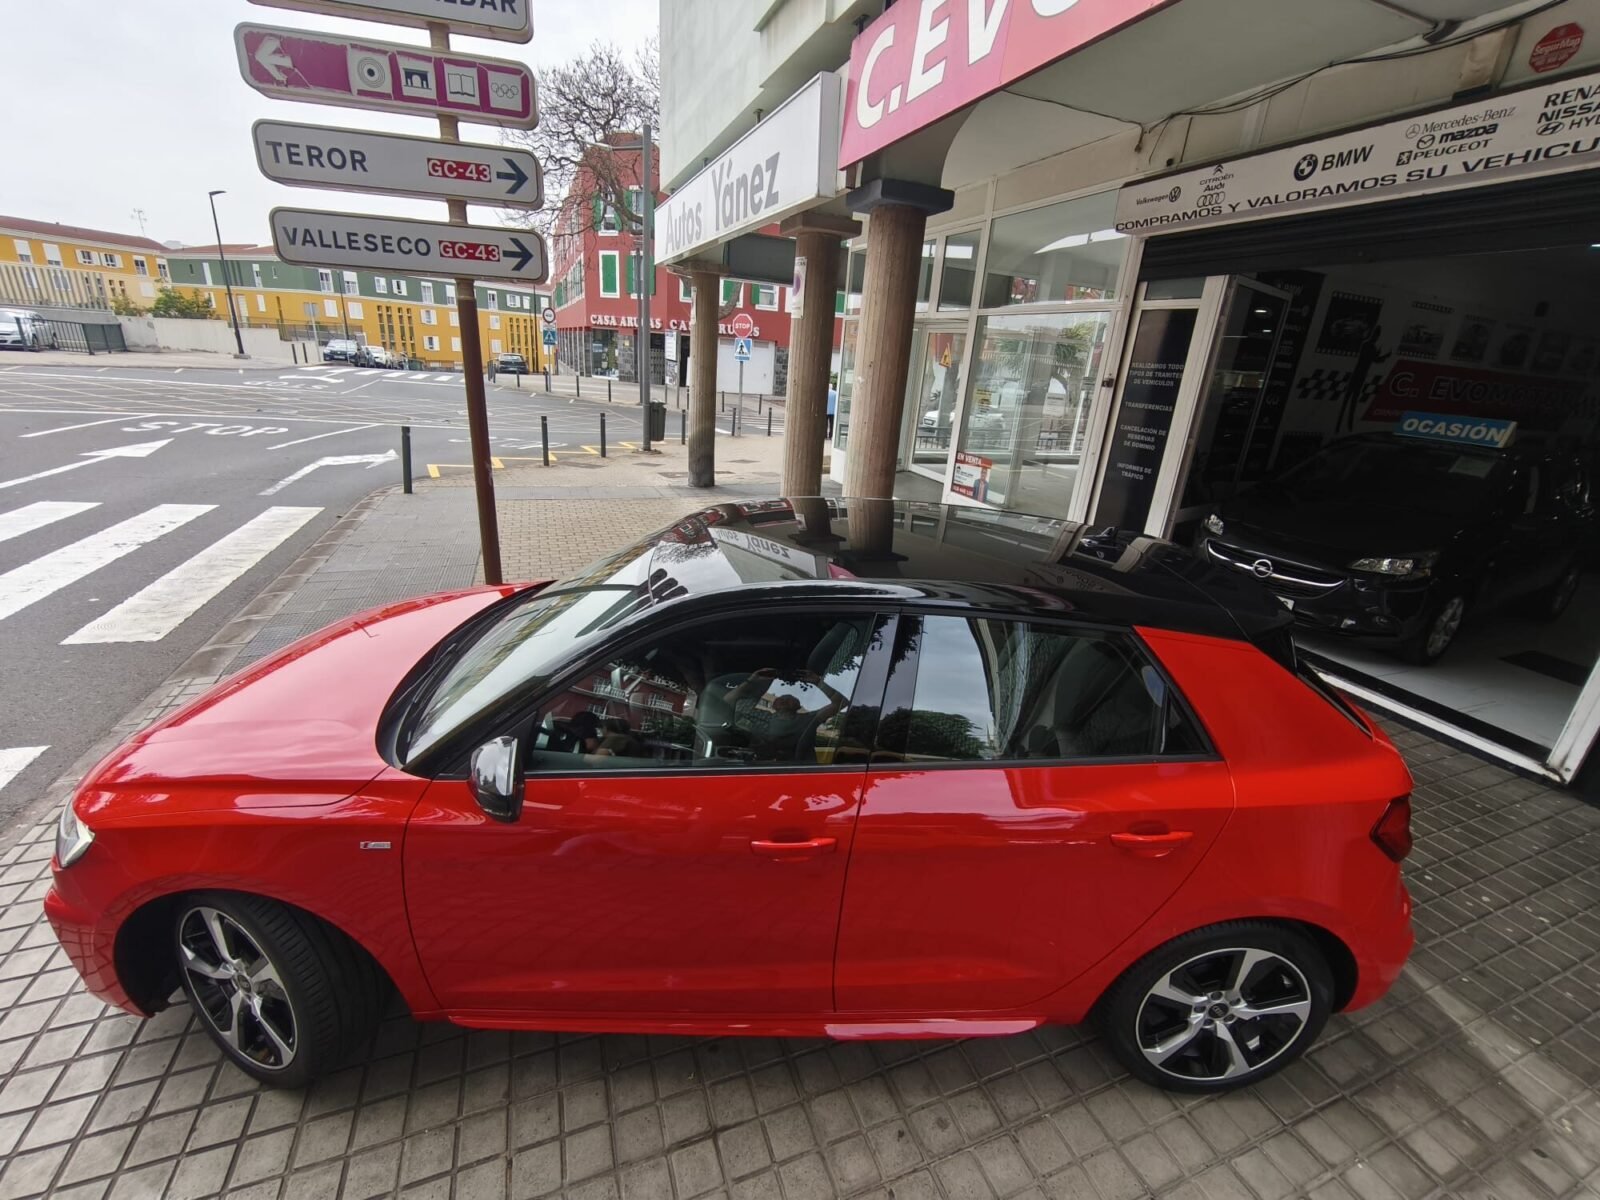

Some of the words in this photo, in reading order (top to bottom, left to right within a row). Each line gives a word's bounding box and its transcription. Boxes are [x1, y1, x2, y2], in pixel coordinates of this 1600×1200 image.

[857, 0, 1083, 129] C.EV
[1421, 106, 1517, 135] Mercedes-Benz
[265, 140, 368, 173] TEROR
[428, 159, 491, 182] GC-43
[1321, 144, 1375, 171] BMW
[1413, 138, 1493, 160] PEUGEOT
[665, 201, 702, 255] Autos
[711, 151, 780, 232] Yánez
[1115, 205, 1222, 232] COMPRAMOS
[1228, 202, 1241, 213] Y
[1247, 174, 1398, 208] VALORAMOS
[1406, 164, 1448, 182] SU
[1136, 194, 1169, 206] Volkswagen
[282, 225, 432, 257] VALLESECO
[439, 241, 500, 262] GC-43
[590, 314, 617, 326] CASA
[620, 316, 662, 329] ARUAS
[1125, 401, 1173, 412] TRANSFERENCIAS
[121, 421, 289, 437] STOP
[1127, 433, 1155, 443] RESERVAS
[1402, 417, 1508, 443] OCASIÓN
[1131, 442, 1156, 451] DOMINIO
[1116, 462, 1144, 473] INFORMES
